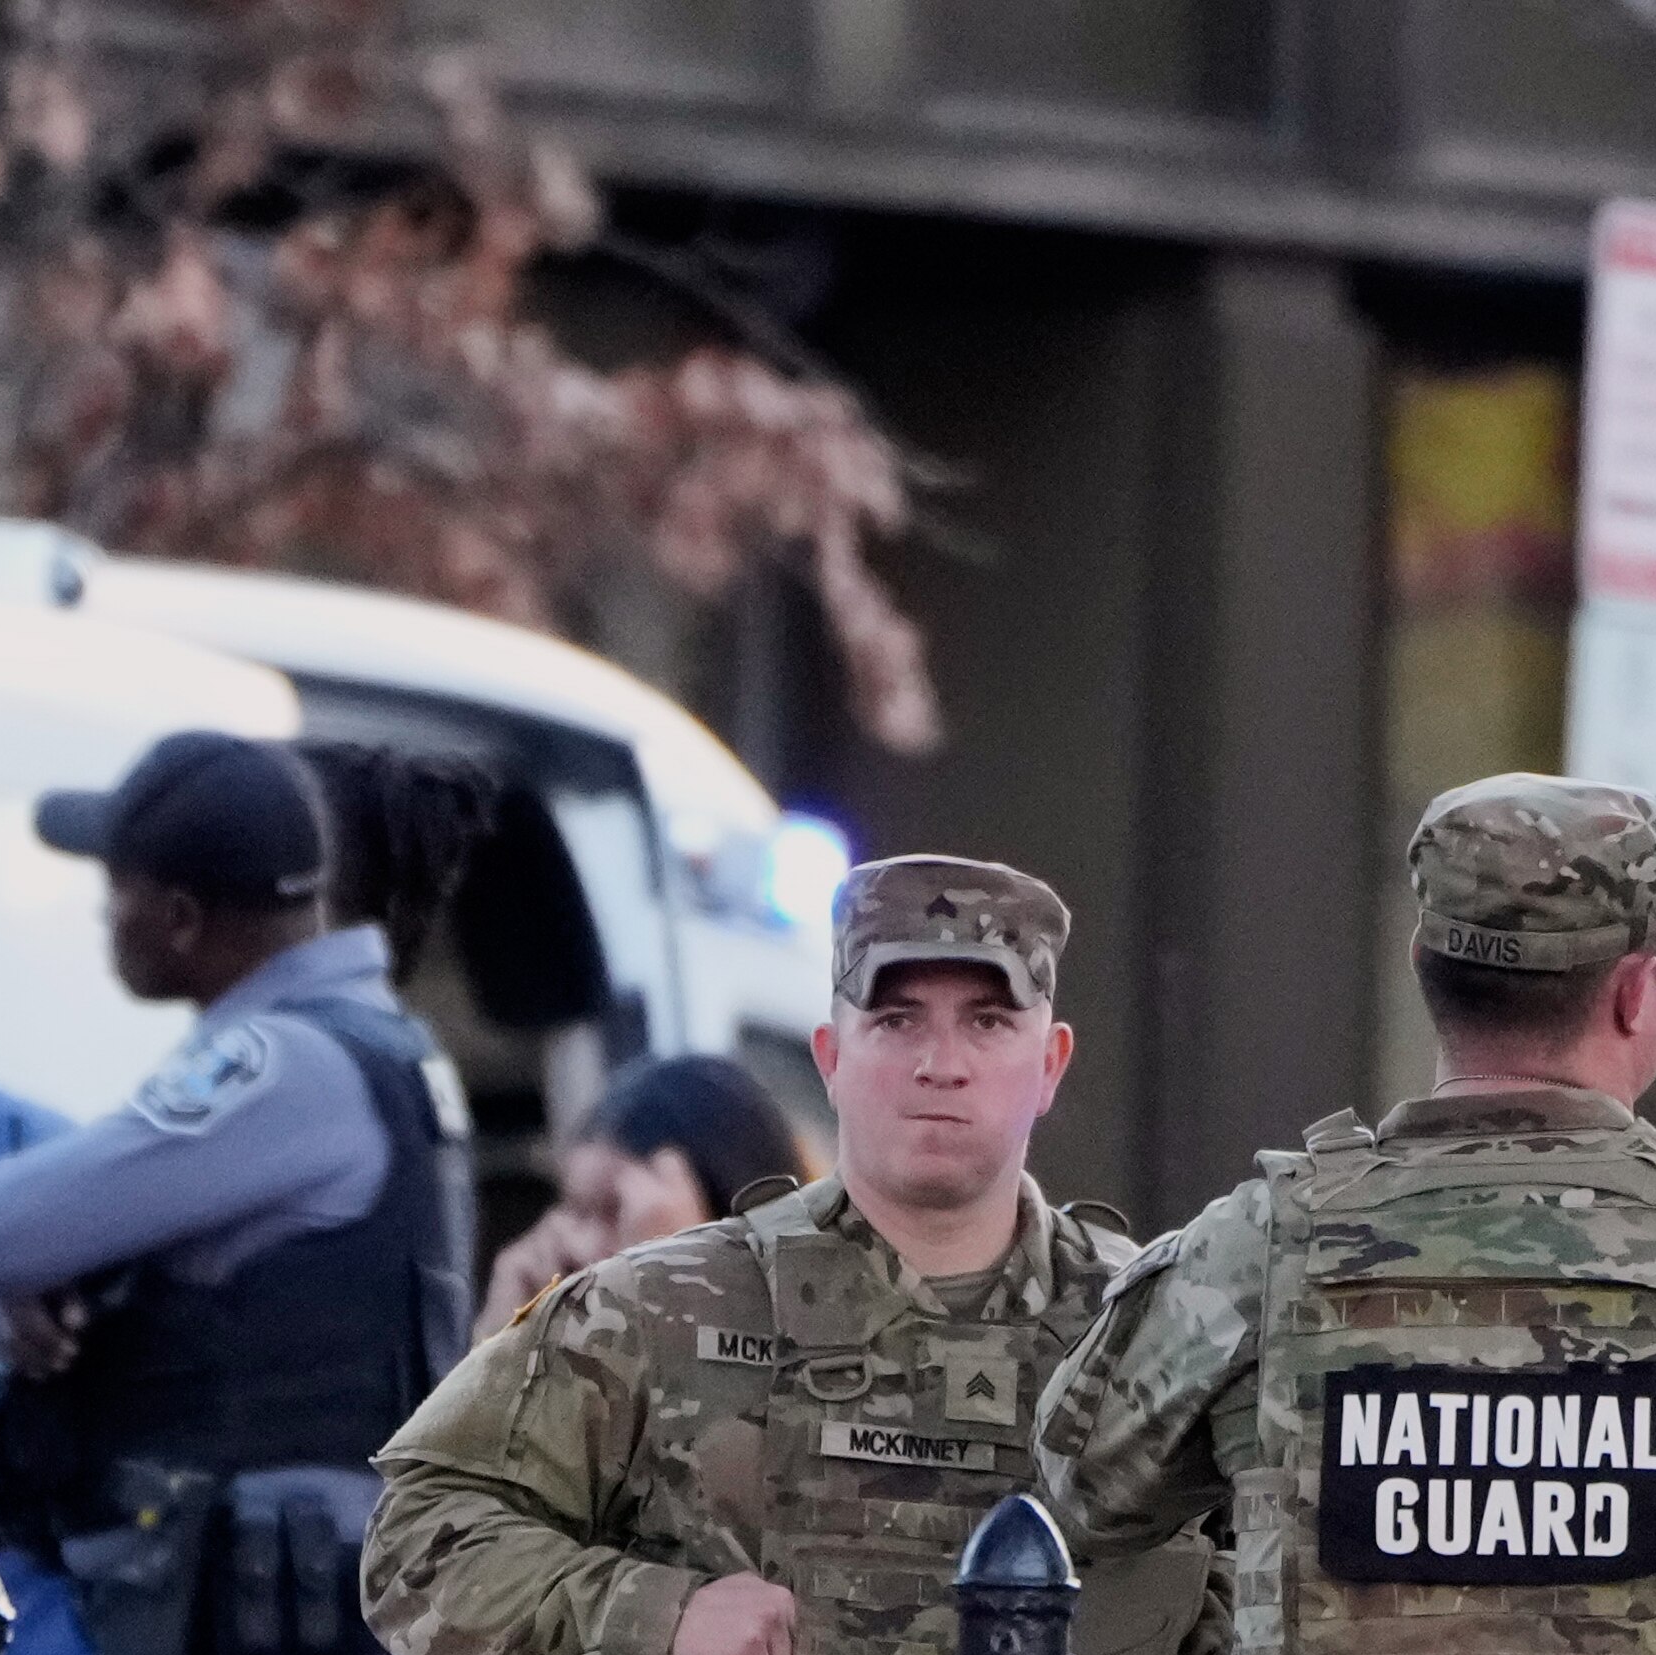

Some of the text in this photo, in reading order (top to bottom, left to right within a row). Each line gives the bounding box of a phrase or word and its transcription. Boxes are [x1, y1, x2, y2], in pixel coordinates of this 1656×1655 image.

[1447, 927, 1524, 965] DAVIS
[717, 1332, 773, 1362] MCK
[848, 1427, 970, 1463] MCKINNEY
[1374, 1476, 1631, 1558] GUARD
